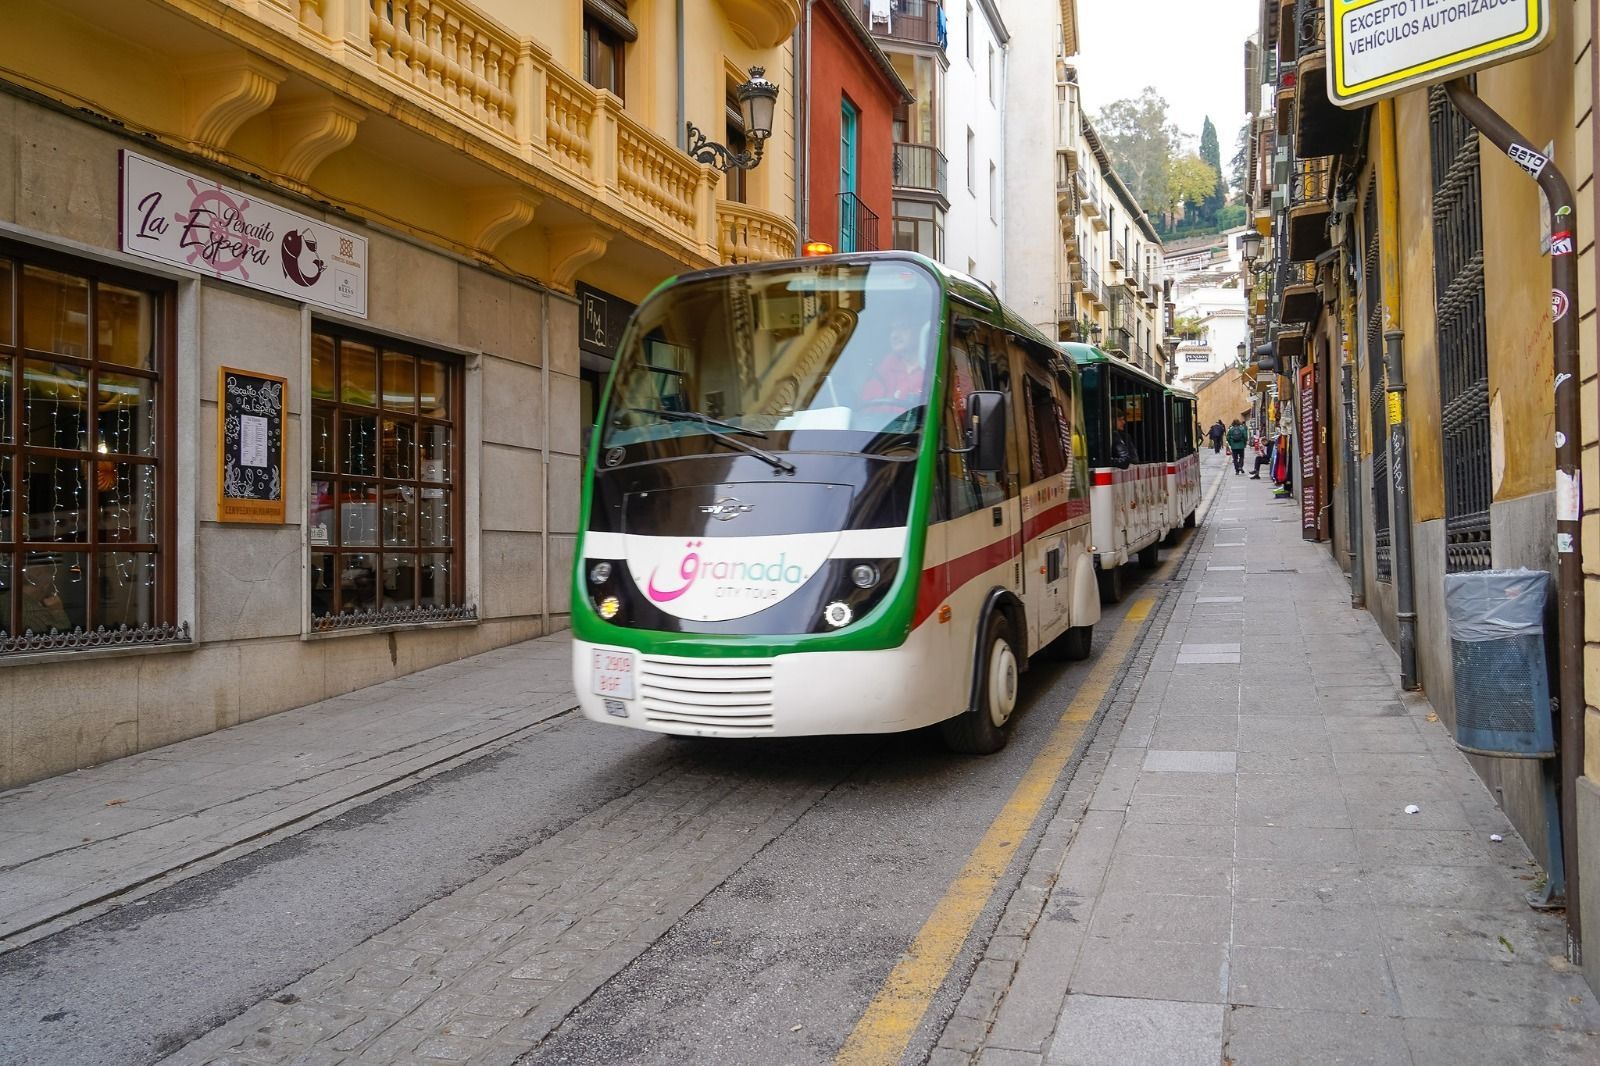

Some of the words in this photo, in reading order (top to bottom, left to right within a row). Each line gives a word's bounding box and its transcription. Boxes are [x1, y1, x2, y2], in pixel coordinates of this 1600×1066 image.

[1349, 19, 1419, 55] VEHÍCULOS
[1422, 0, 1517, 32] AUTORIZAD
[1350, 1, 1407, 34] EXCEPTO
[136, 191, 169, 239] La
[180, 208, 270, 266] Espera
[241, 396, 251, 410] La
[252, 398, 277, 416] Espera
[714, 585, 742, 598] CITY
[744, 586, 779, 600] TOUR
